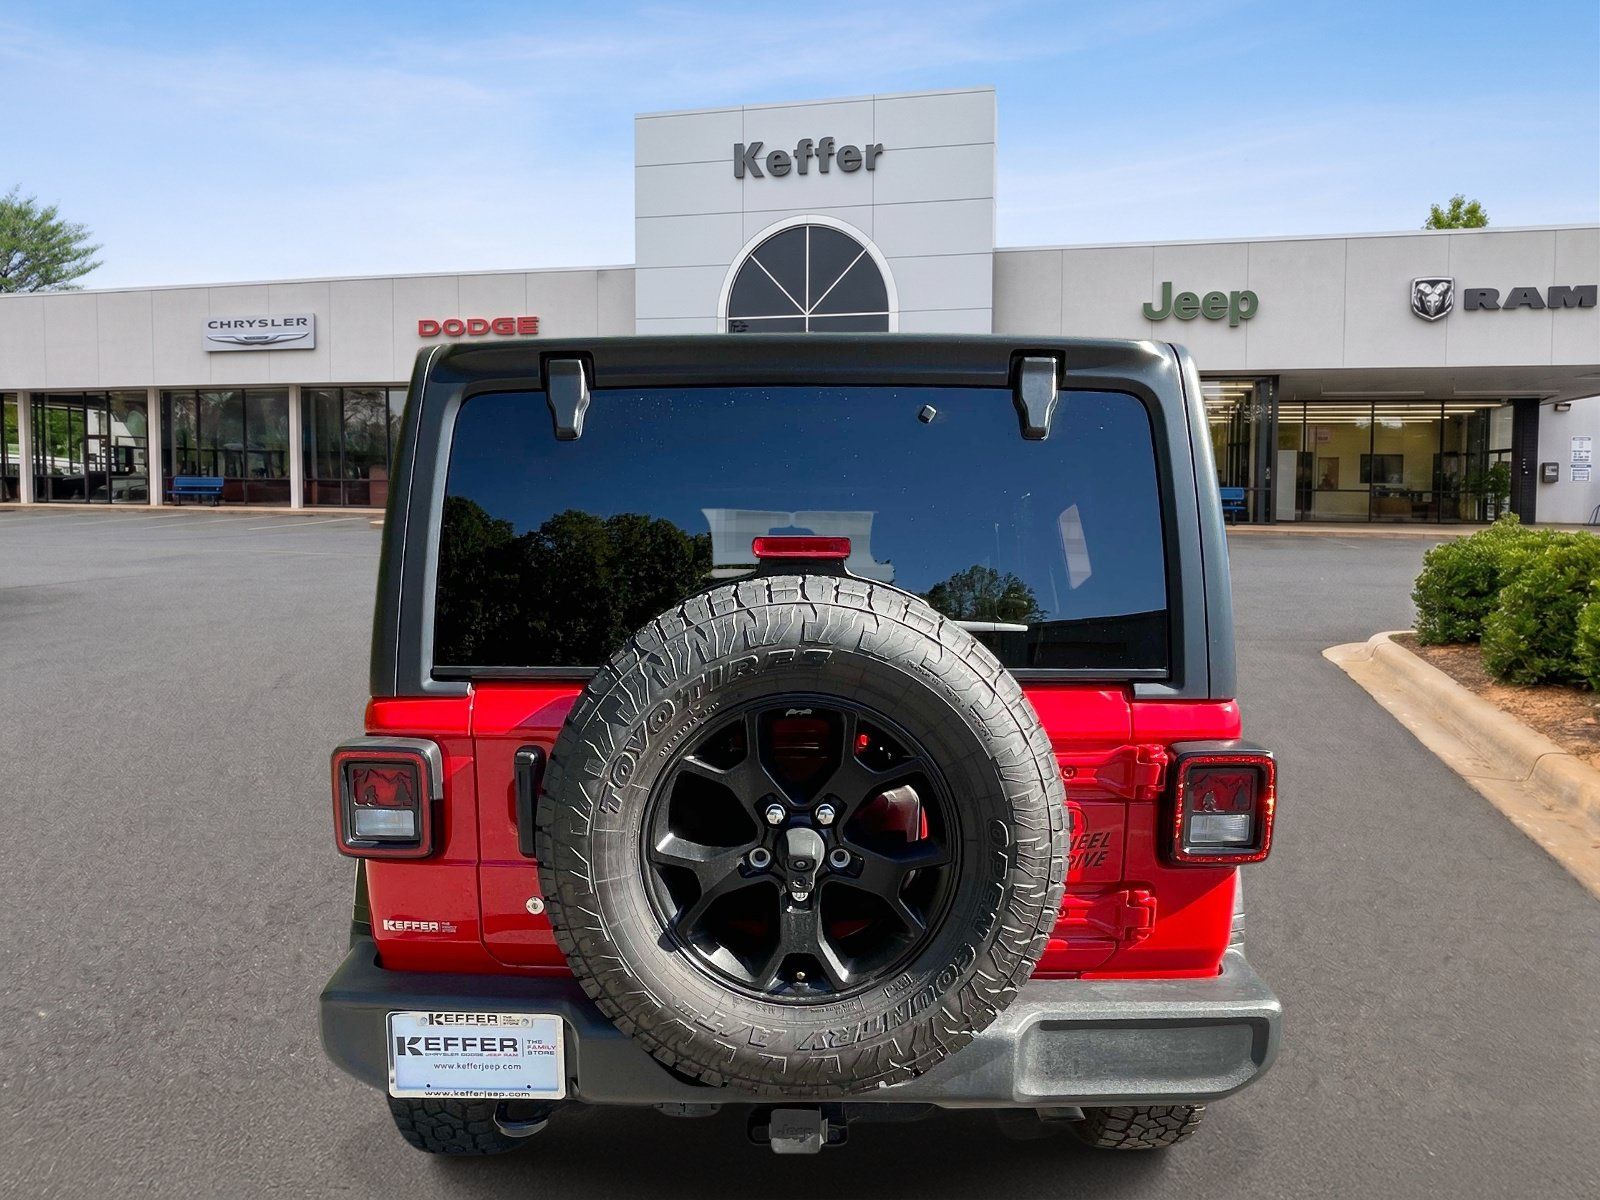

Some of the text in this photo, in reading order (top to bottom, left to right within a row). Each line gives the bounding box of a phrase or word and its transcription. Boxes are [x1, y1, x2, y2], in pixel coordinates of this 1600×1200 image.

[734, 136, 883, 178] Keffer
[1143, 281, 1259, 327] Jeep
[1464, 285, 1598, 311] RAM
[207, 317, 308, 330] CHRYSLER
[418, 316, 539, 337] DODGE
[599, 699, 676, 814] TOYO
[1070, 832, 1111, 850] EEL
[1070, 851, 1109, 871] RIVE
[971, 818, 1010, 942] OPEN
[383, 919, 439, 931] KEFFER
[796, 943, 978, 1051] COUNTRY
[428, 1013, 498, 1026] KEFFER
[396, 1036, 518, 1056] KEFFER
[433, 1062, 522, 1072] www.kefferjeep.com
[424, 1090, 531, 1098] www.kefferjeep.com
